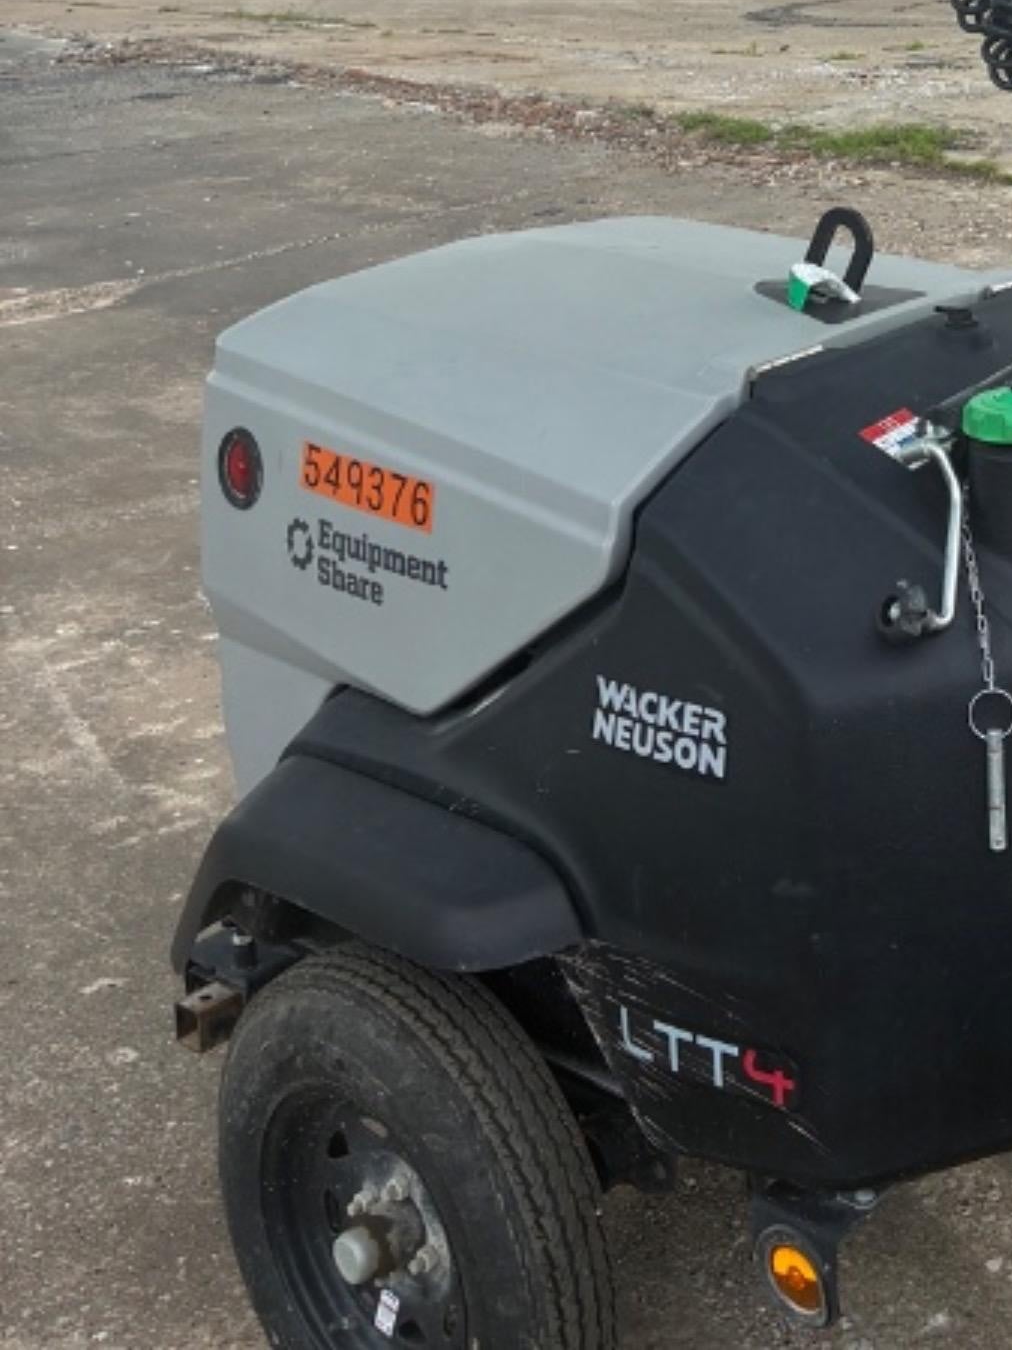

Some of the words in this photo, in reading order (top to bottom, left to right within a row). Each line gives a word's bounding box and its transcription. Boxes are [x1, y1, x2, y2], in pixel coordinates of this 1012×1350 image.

[304, 443, 431, 527] 549376
[317, 519, 448, 590] Equipment
[317, 556, 384, 606] Share
[597, 674, 728, 744] WACKER
[593, 712, 727, 778] NEUSON
[620, 1004, 795, 1107] LTT4
